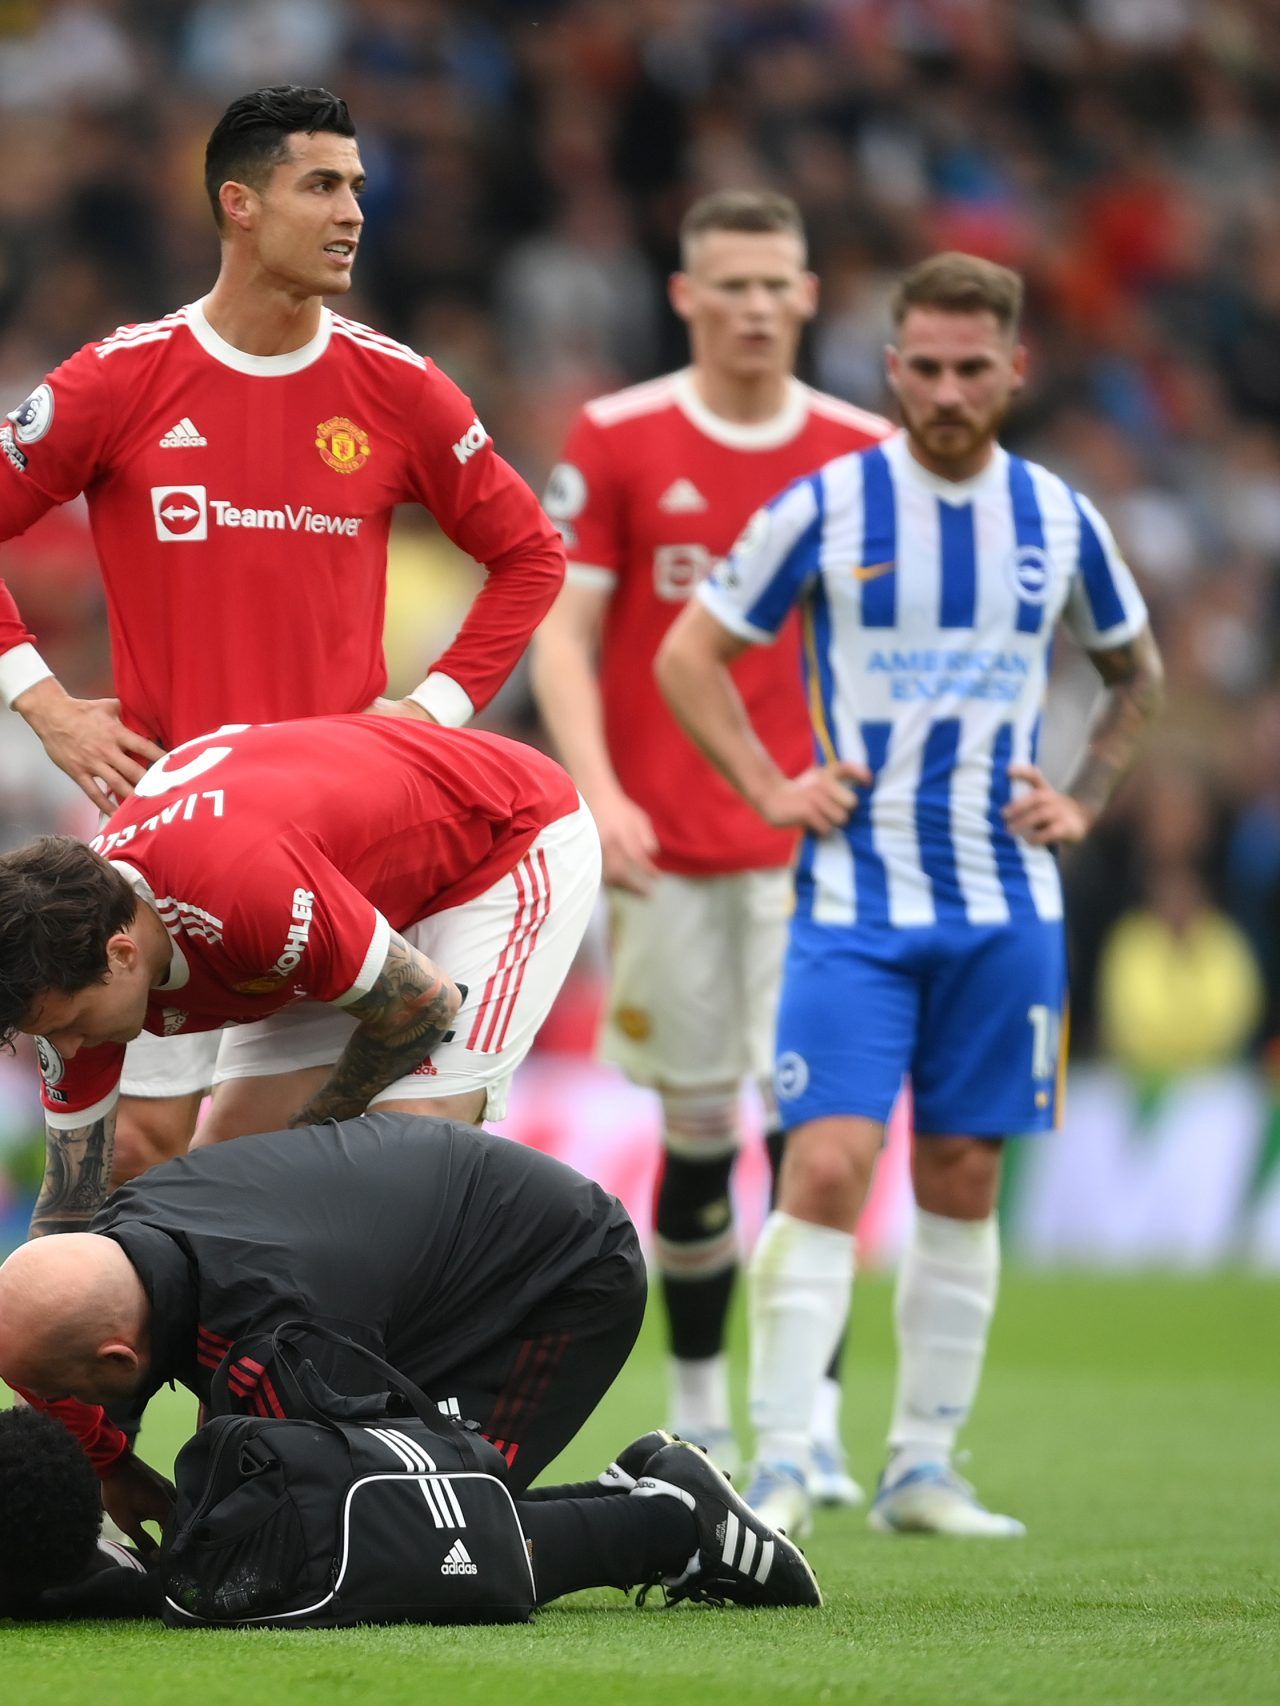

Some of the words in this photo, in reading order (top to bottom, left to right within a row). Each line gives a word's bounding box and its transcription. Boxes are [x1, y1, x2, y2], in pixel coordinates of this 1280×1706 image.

[159, 435, 208, 448] adidas
[451, 417, 488, 465] KO
[209, 500, 362, 537] TeamViewer
[268, 887, 316, 978] KOHLER
[1027, 1003, 1061, 1079] 1
[440, 1562, 478, 1575] adidas
